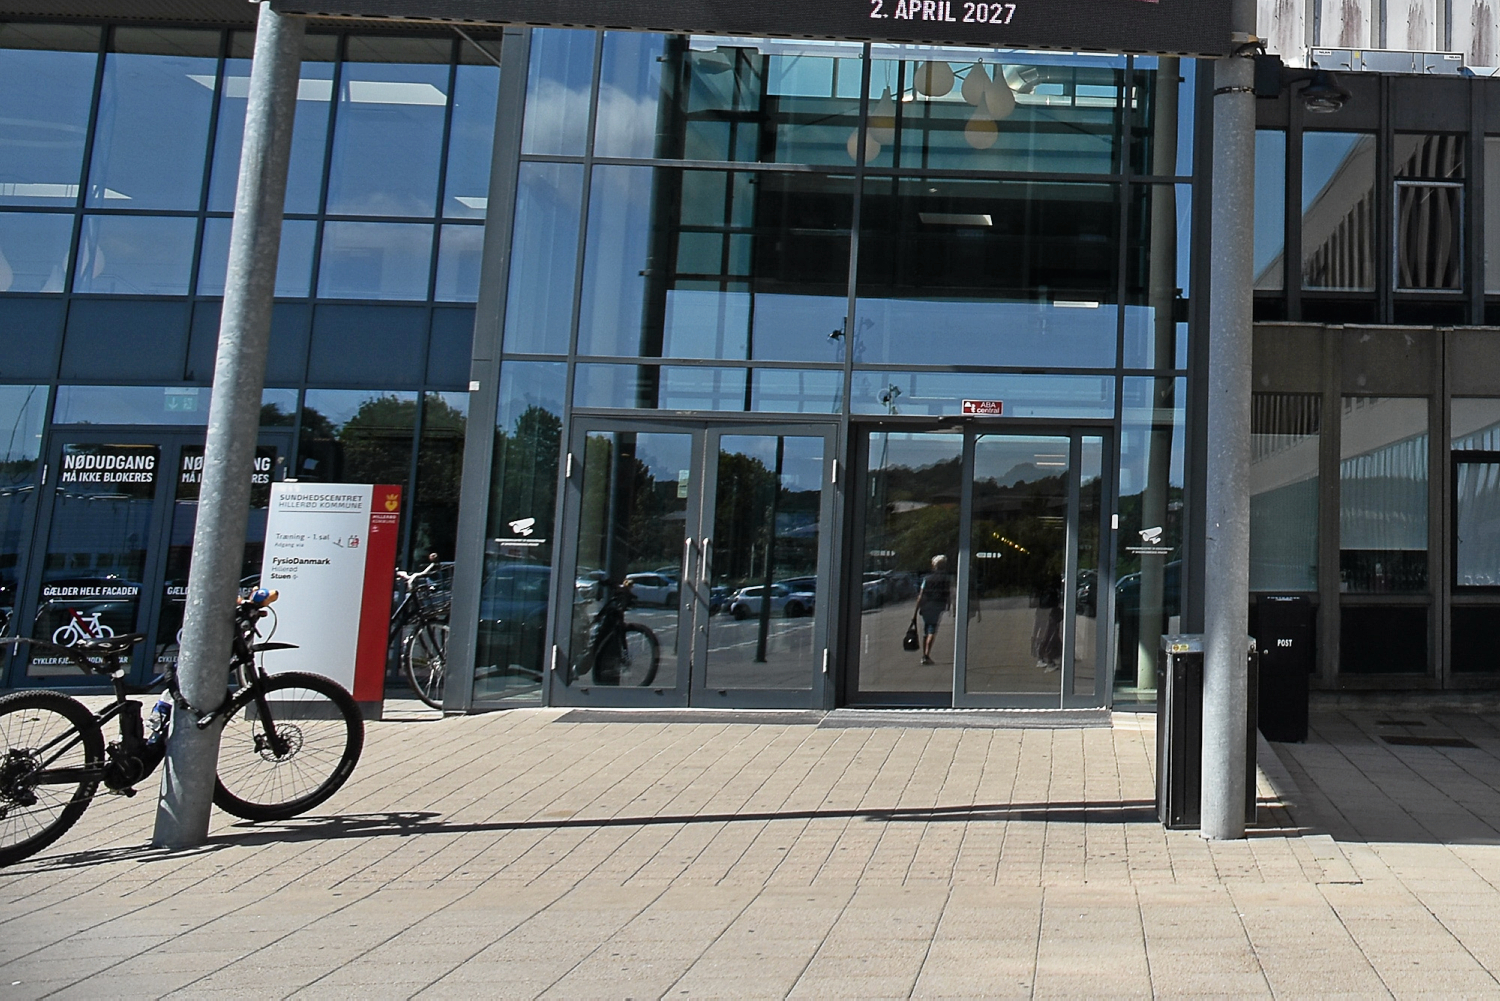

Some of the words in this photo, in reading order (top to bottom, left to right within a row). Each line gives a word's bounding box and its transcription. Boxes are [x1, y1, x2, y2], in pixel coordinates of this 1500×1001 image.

[894, 0, 956, 23] APRIL
[962, 2, 1017, 25] 2027
[64, 454, 155, 471] NØDUDGANG
[62, 471, 77, 483] MÅ
[78, 472, 102, 483] IKKE
[103, 472, 153, 484] BLOKERES
[181, 471, 196, 483] MÅ
[279, 494, 363, 502] SUNDHEDSCENTRET
[278, 501, 317, 509] HILLERØD
[319, 502, 363, 510] KOMMUNE
[272, 557, 331, 566] FysioDanmark
[43, 586, 79, 596] GÆLDER
[79, 586, 102, 596] HELE
[102, 586, 139, 596] FACADEN
[1277, 638, 1293, 647] POST
[32, 657, 57, 665] CYKLER
[157, 655, 178, 663] CYKLE
